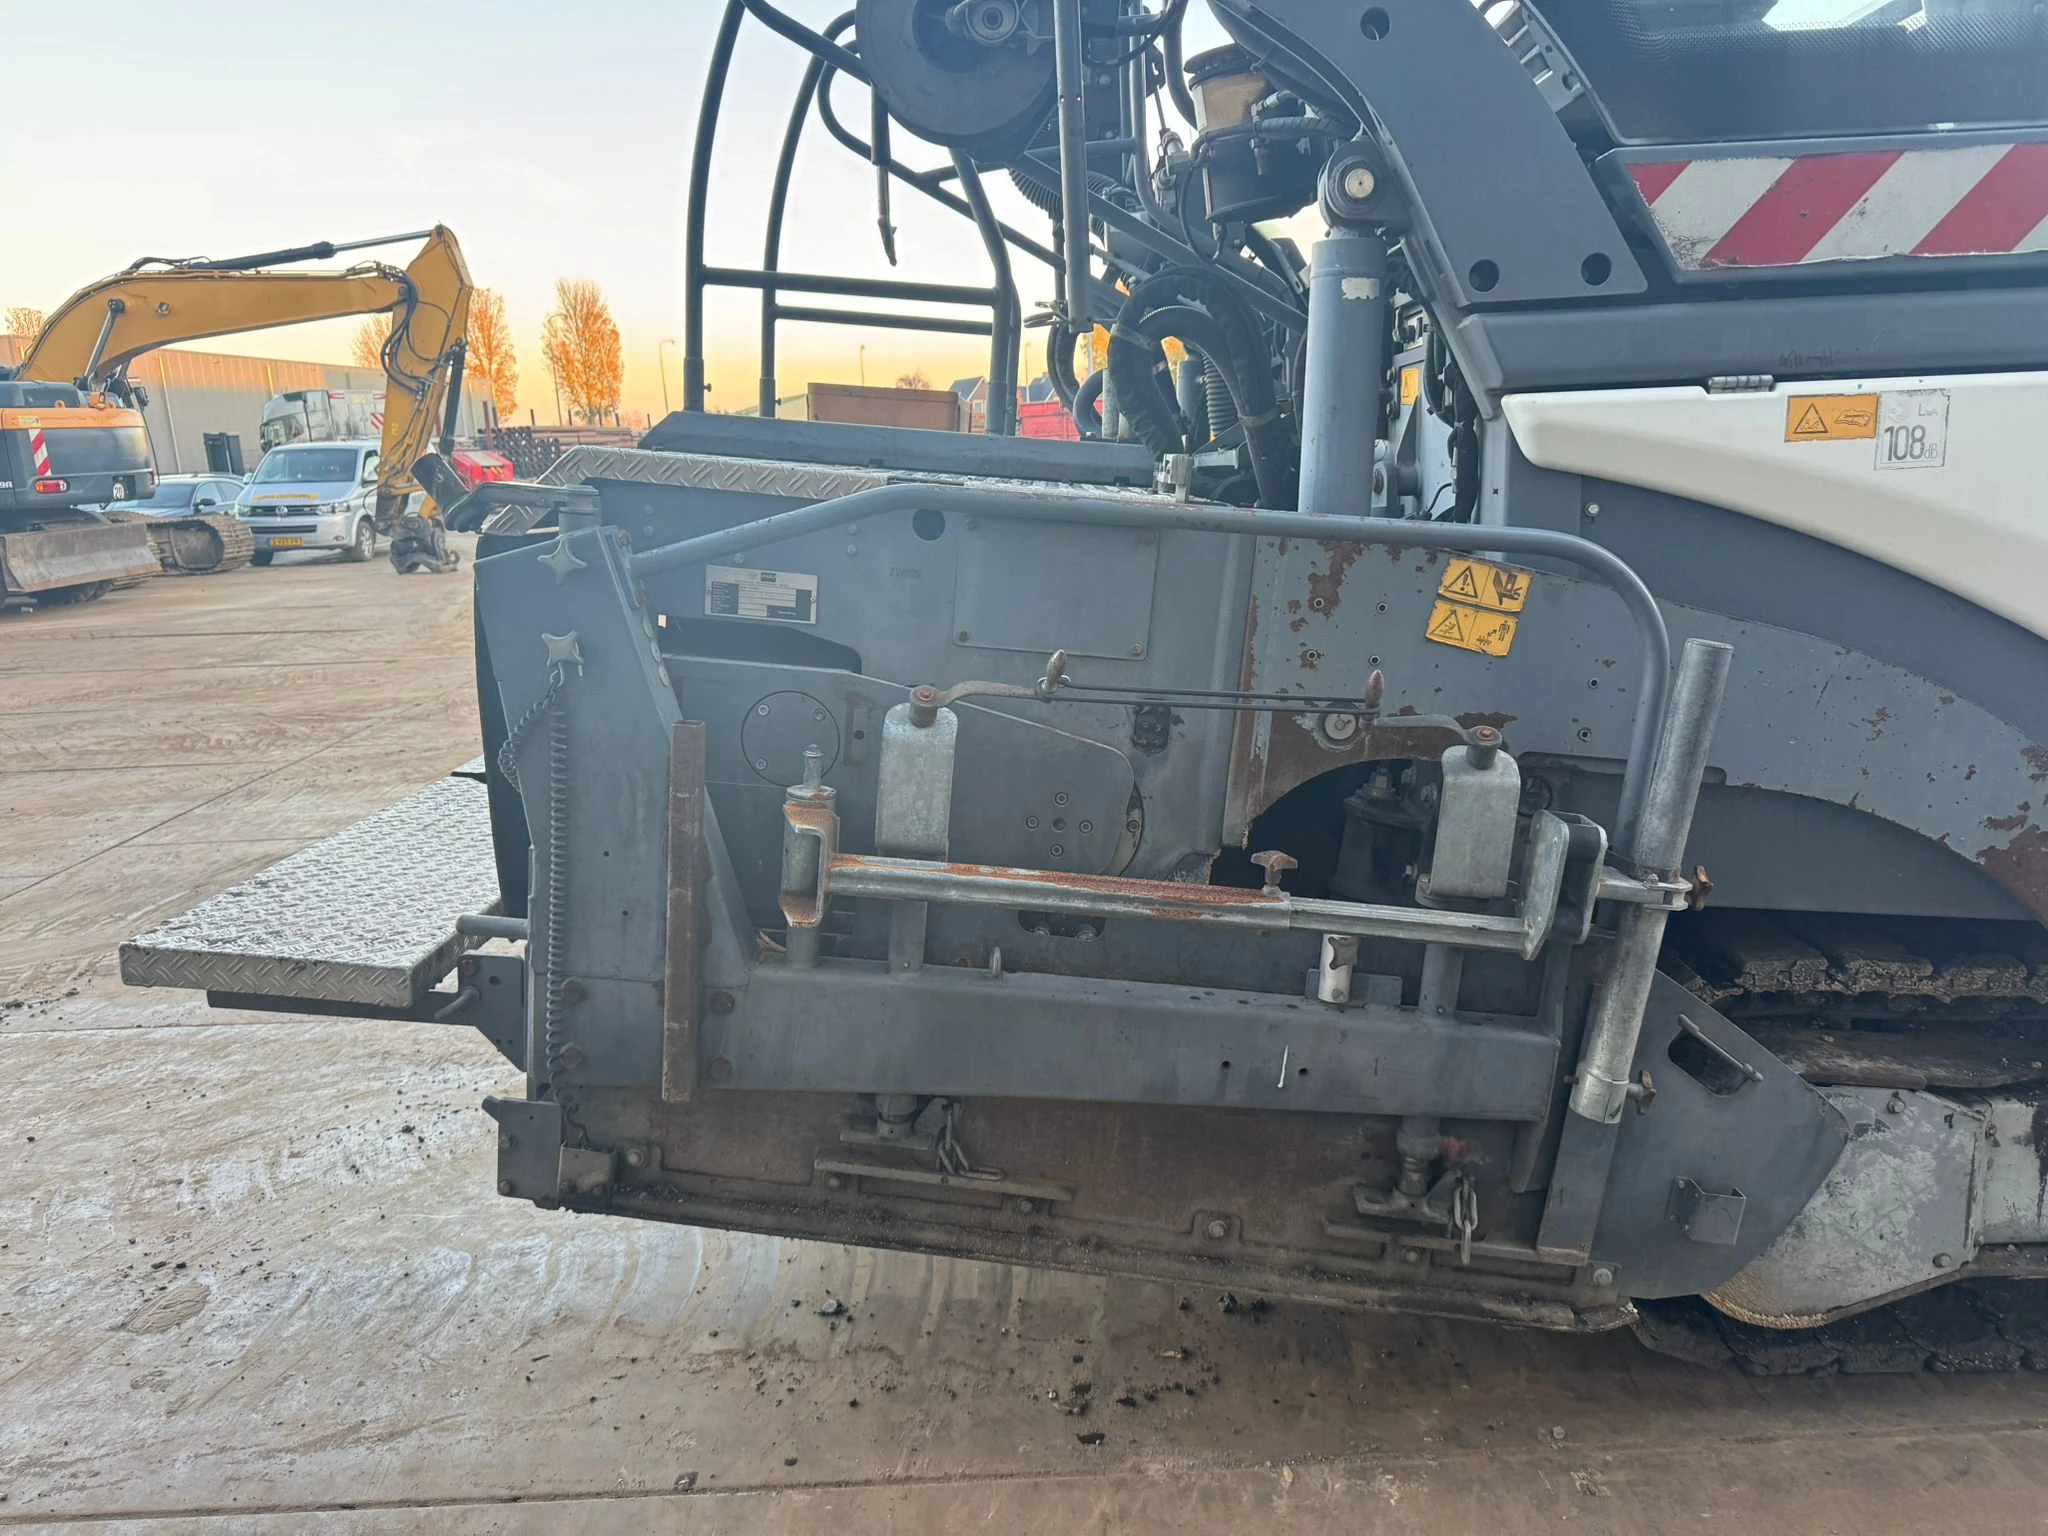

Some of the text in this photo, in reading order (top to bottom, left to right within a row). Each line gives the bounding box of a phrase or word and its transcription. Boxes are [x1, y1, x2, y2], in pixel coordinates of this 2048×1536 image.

[1884, 424, 1938, 461] 108 dB
[114, 486, 125, 499] 20
